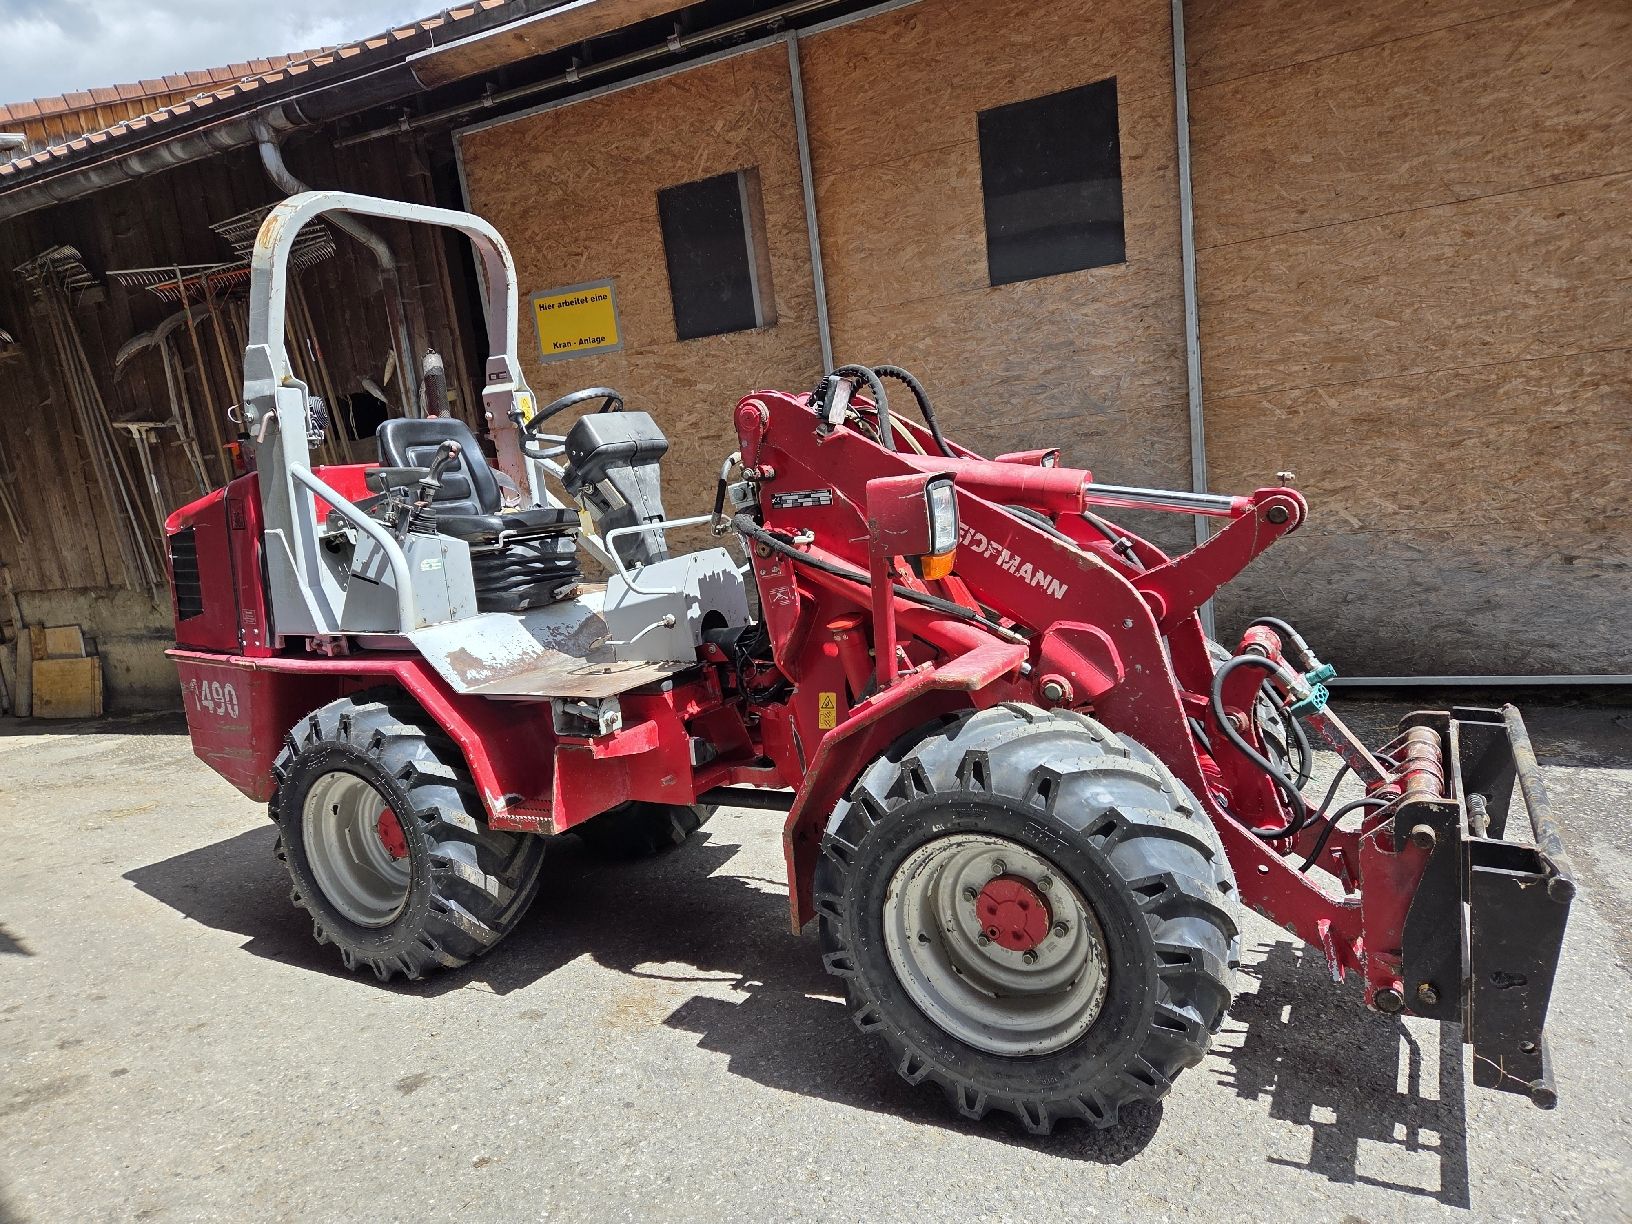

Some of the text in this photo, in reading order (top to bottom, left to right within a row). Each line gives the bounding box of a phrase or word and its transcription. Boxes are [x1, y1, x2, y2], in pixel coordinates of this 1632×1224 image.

[538, 293, 608, 312] Hier arbeitet eine
[553, 341, 572, 350] Kran
[578, 336, 606, 346] Anlage
[189, 678, 239, 719] 1490
